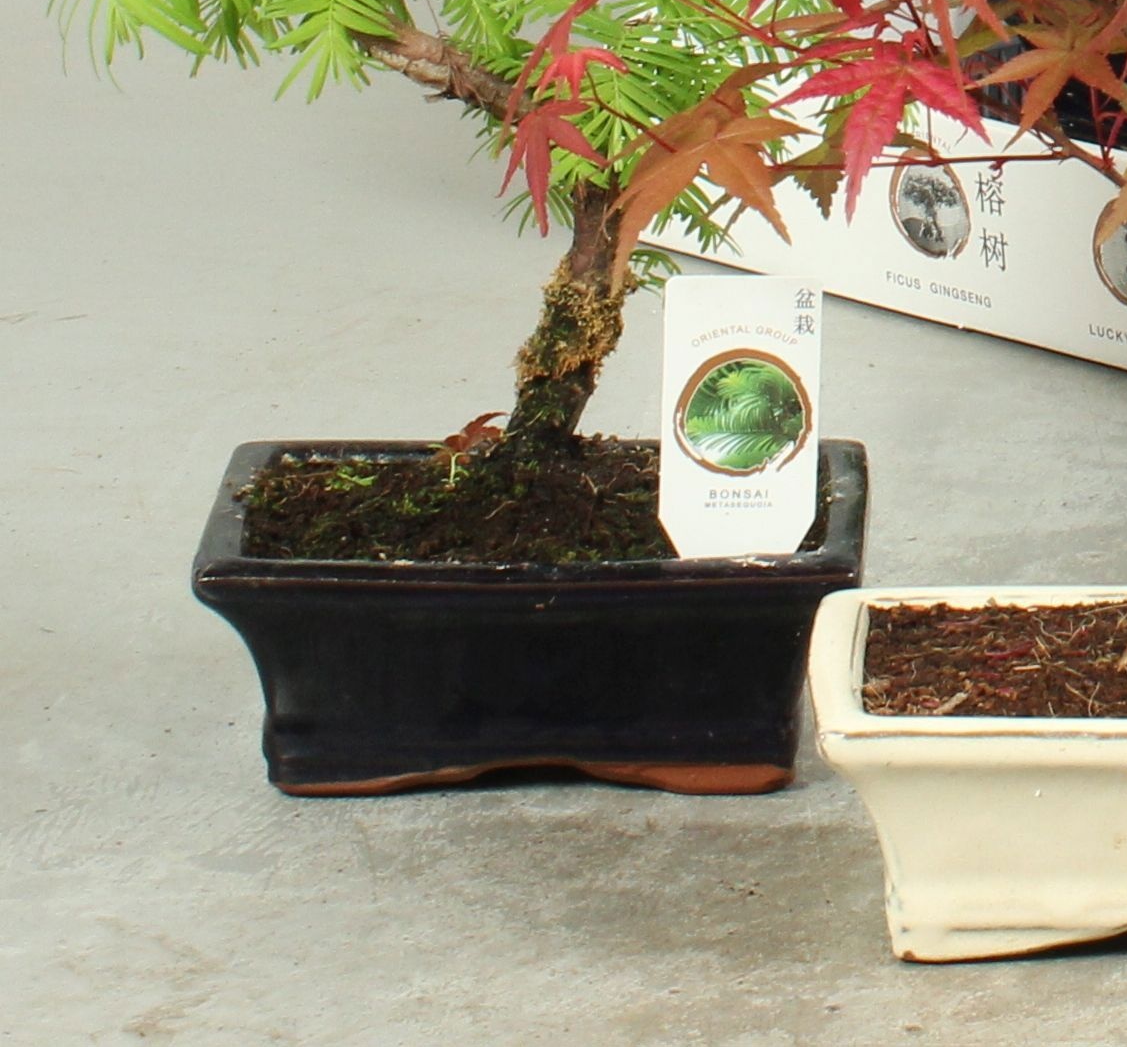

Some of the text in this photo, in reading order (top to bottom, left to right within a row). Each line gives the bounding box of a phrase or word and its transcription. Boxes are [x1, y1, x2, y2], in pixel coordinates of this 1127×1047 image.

[975, 170, 1008, 273] 榕树
[886, 270, 992, 309] FICUS GINGSENG
[793, 288, 816, 335] 盆栽
[691, 325, 799, 348] ORIENTAL GROUP
[709, 489, 769, 500] BONSAI
